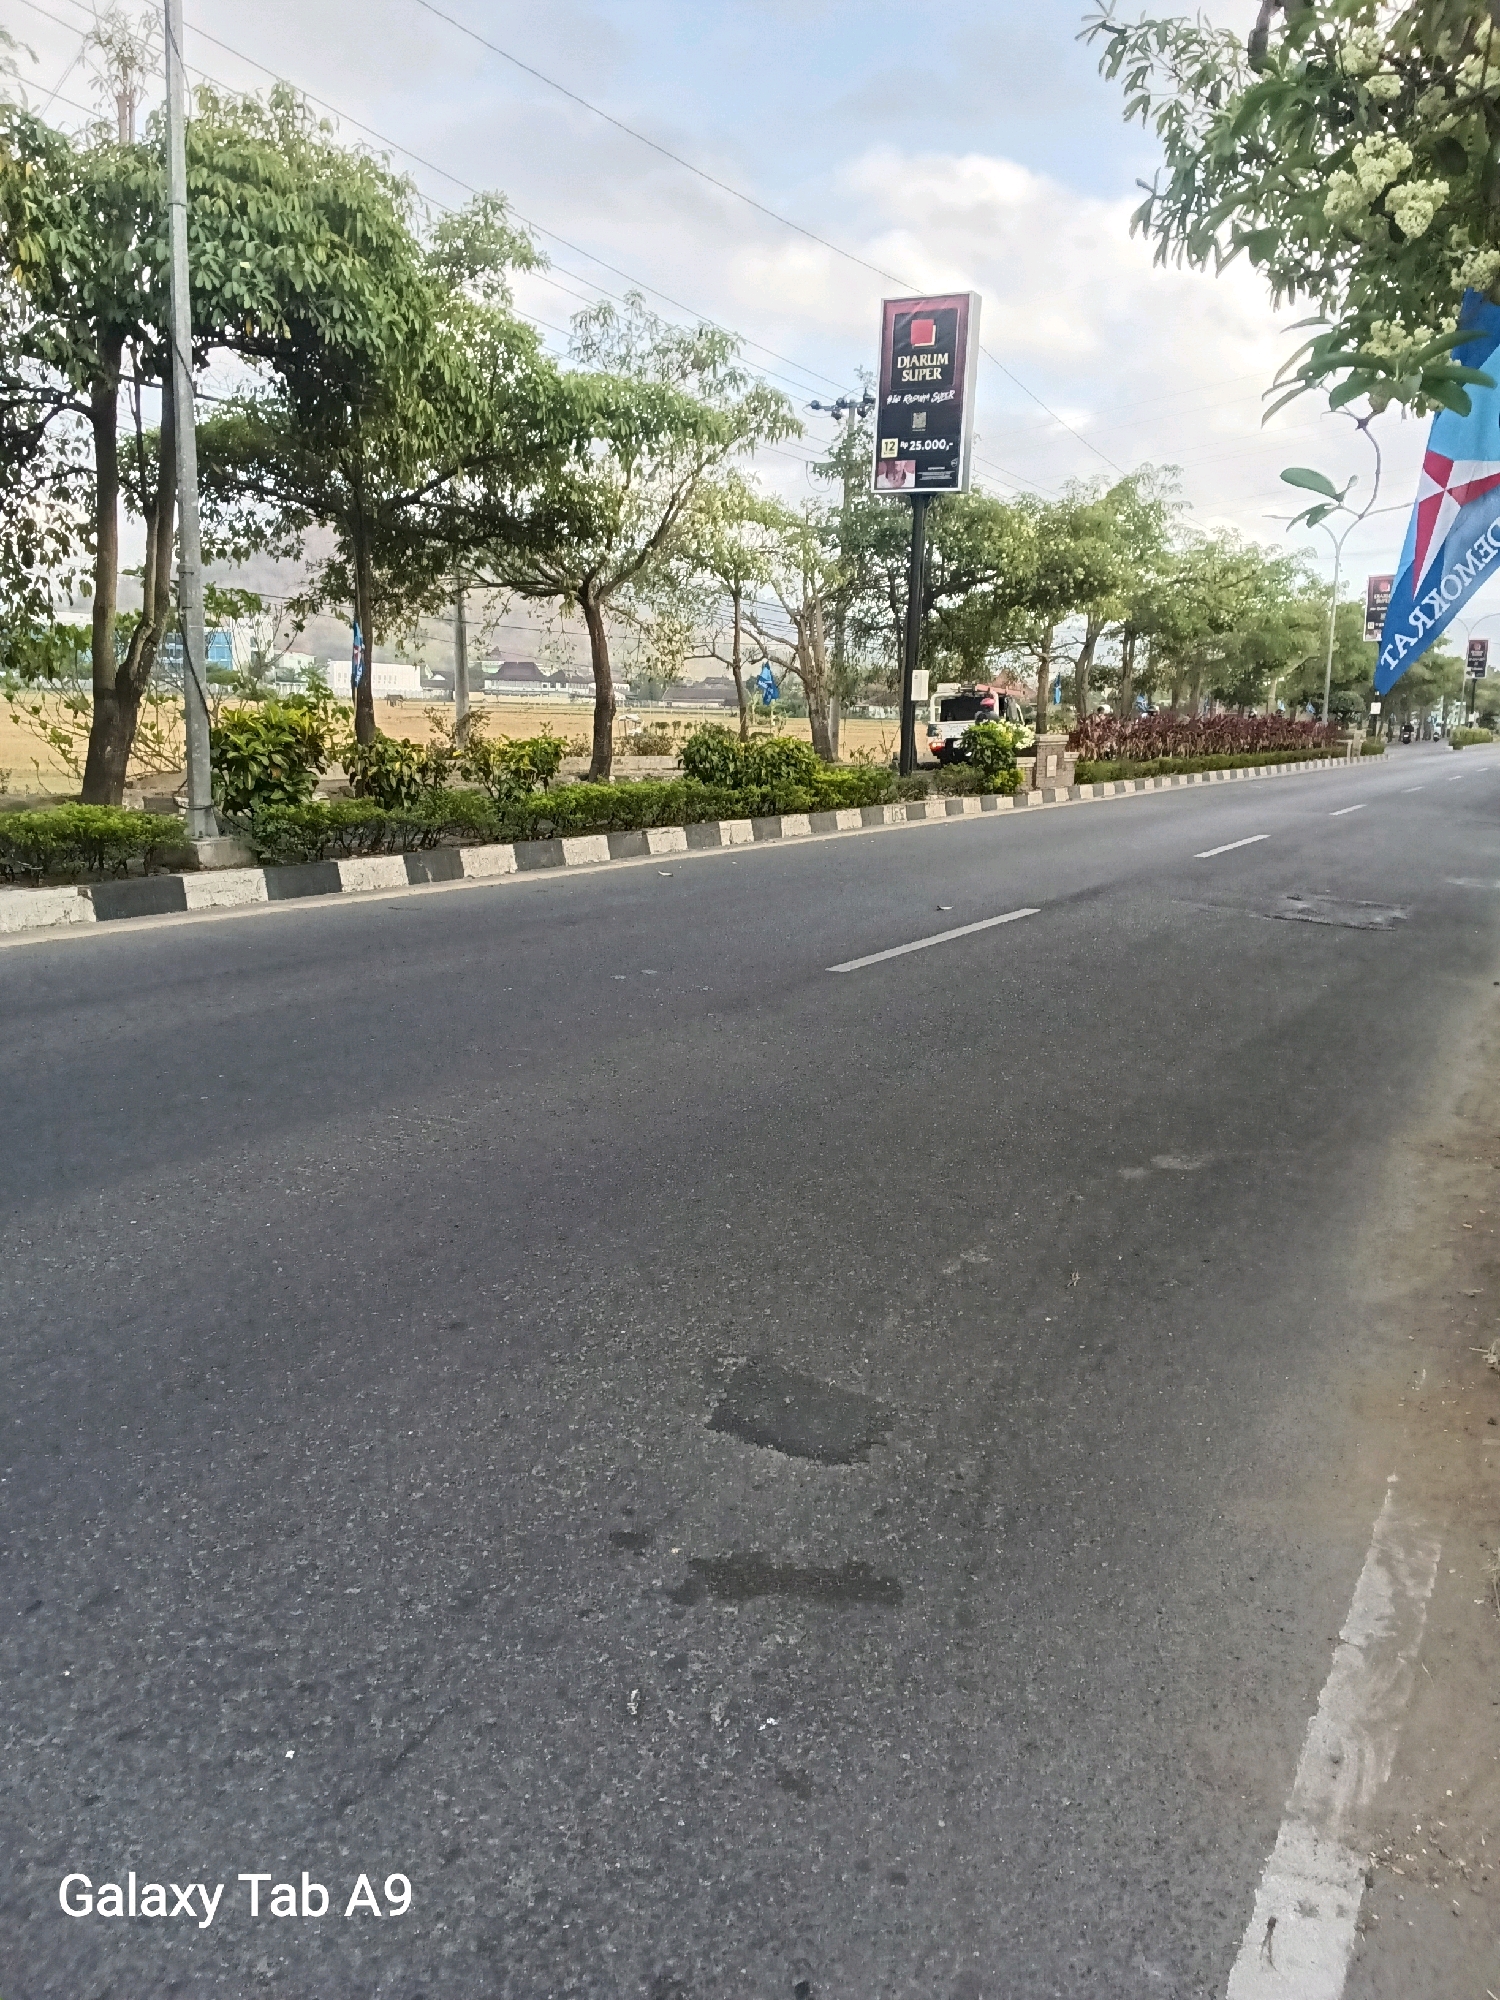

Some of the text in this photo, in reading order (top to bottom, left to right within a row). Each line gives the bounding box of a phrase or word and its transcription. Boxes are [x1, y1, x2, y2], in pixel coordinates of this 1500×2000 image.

[897, 352, 949, 368] DJARUM
[901, 367, 942, 382] SUPER
[884, 438, 954, 452] 12 Rp 25.000,-
